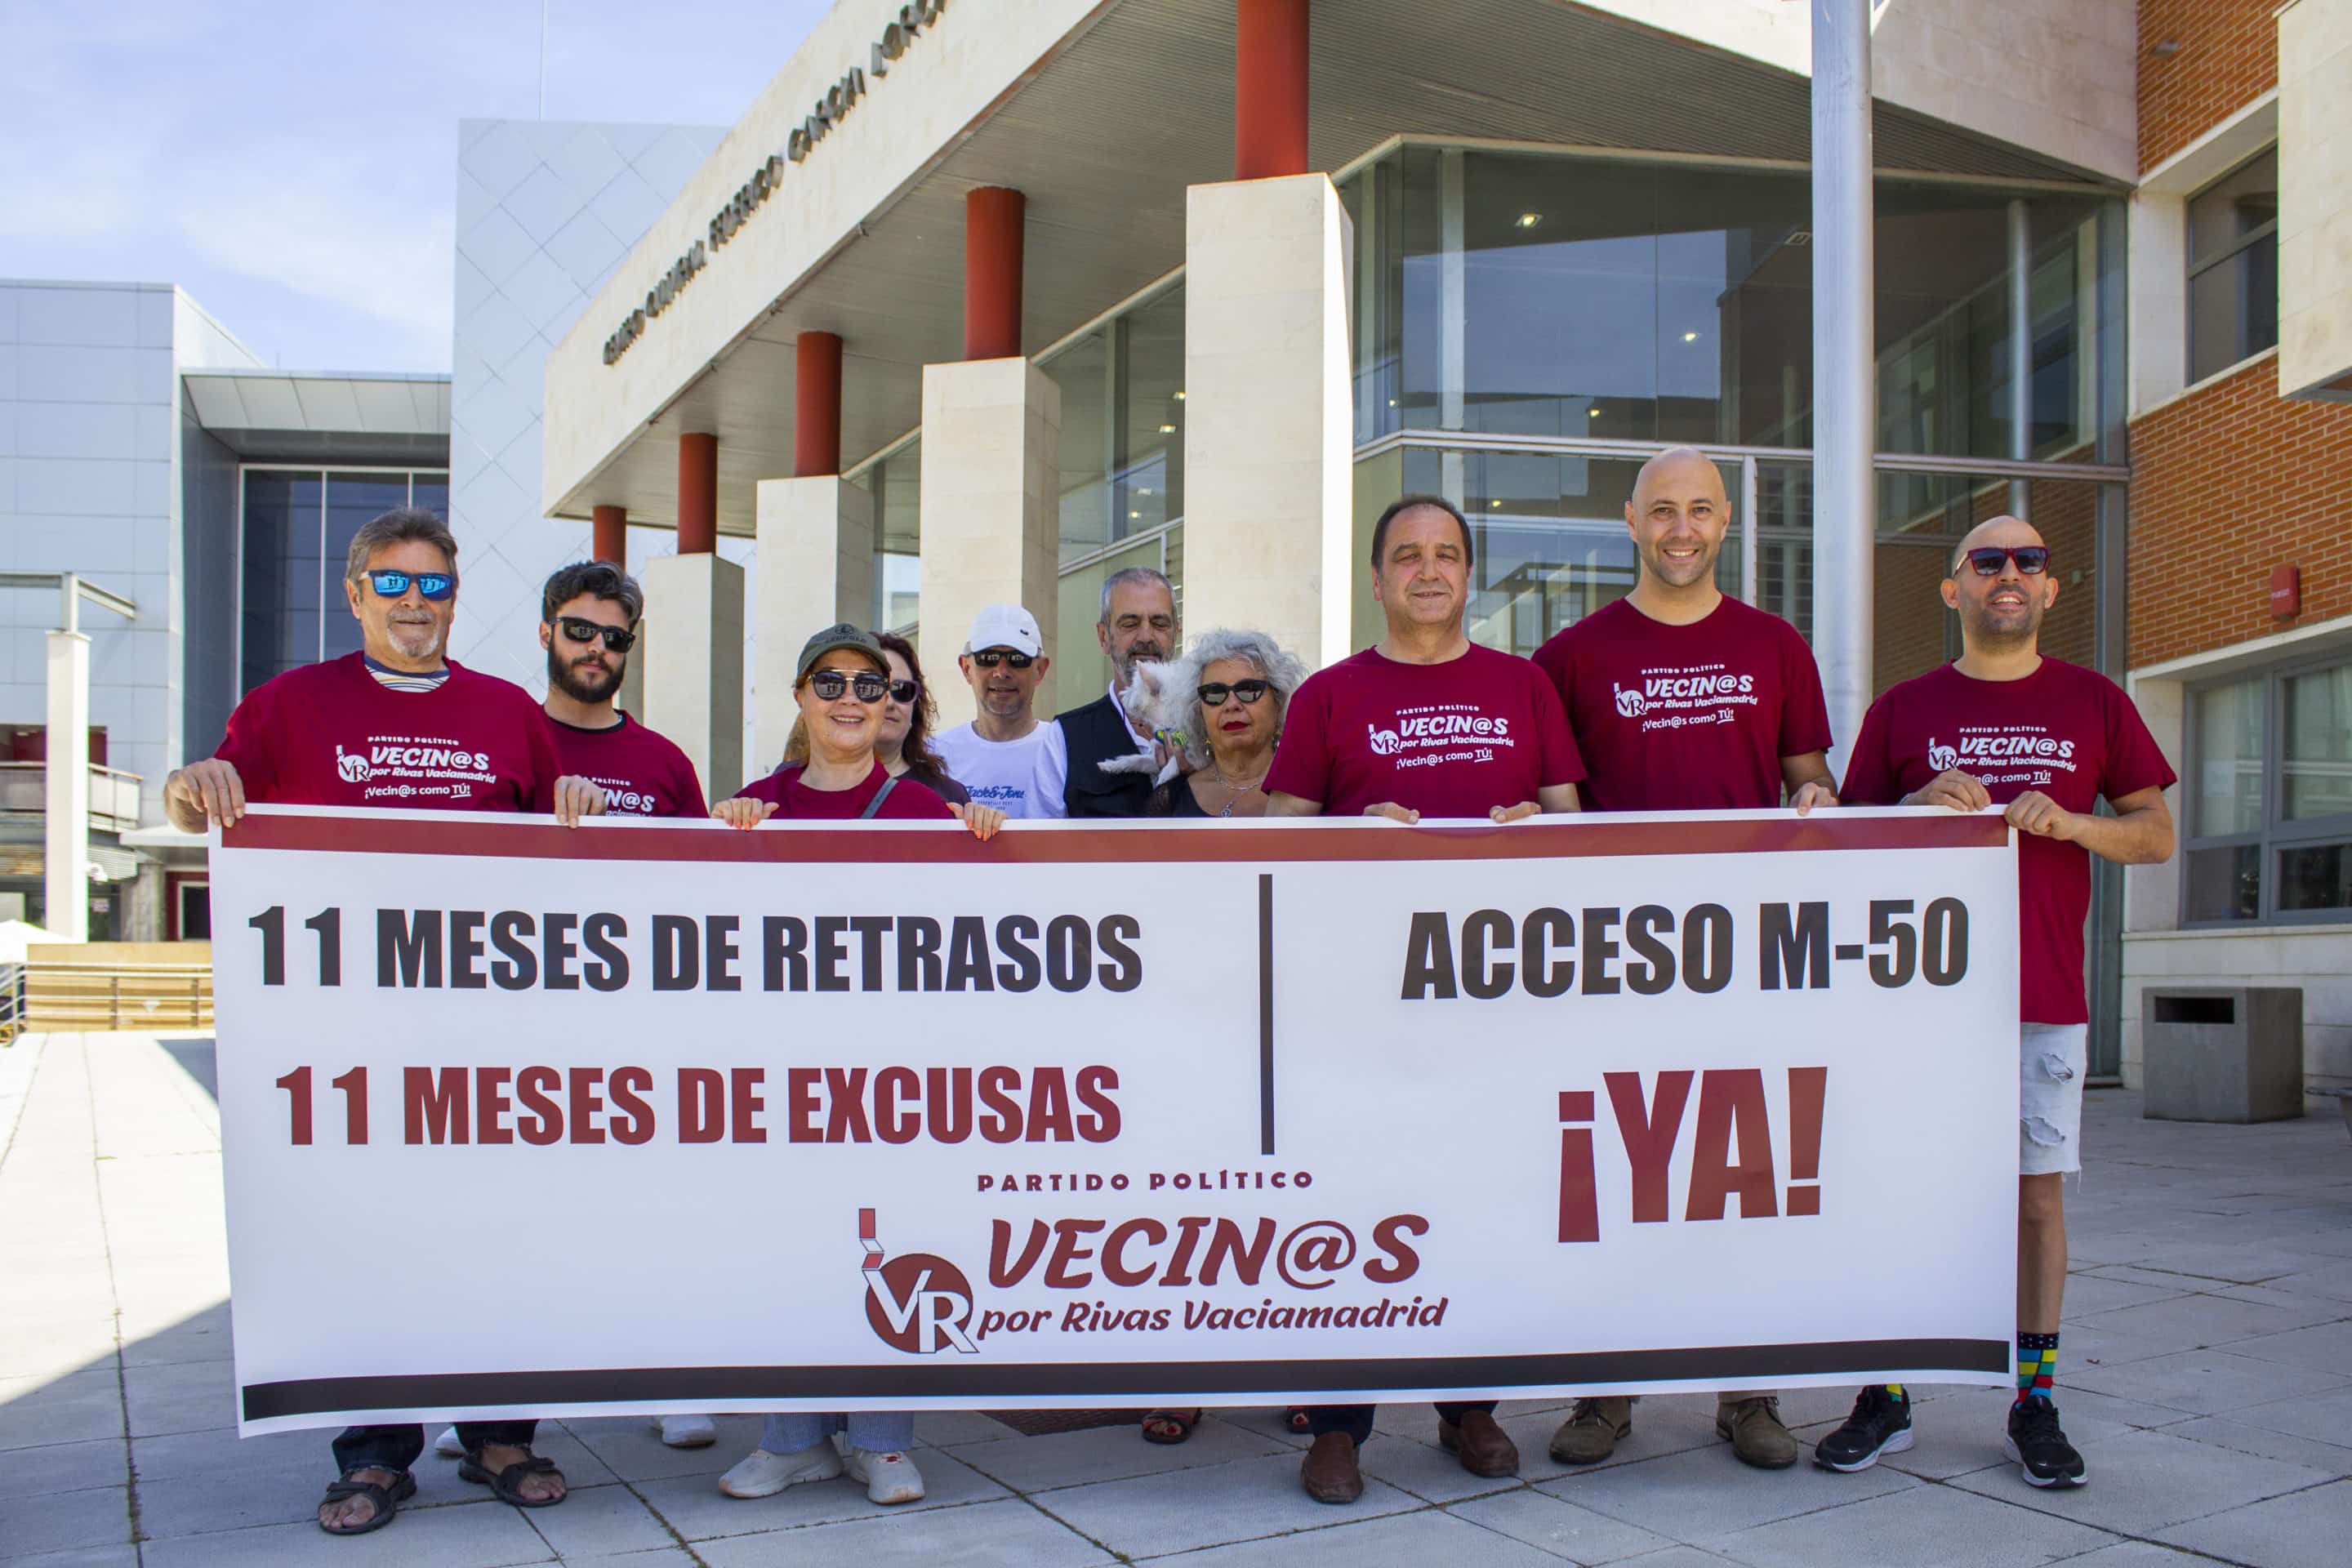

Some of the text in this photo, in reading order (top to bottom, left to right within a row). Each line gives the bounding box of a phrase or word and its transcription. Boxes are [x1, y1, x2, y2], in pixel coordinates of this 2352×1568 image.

[1642, 664, 1725, 675] PARTIDO POLÍTICO
[1645, 675, 1753, 697] VECIN@S
[1396, 704, 1480, 715] PARTIDO POLÍTICO
[1645, 694, 1757, 712] por Rivas Vaciamadrid
[1400, 715, 1508, 737] VECIN@S
[1642, 707, 1735, 732] ¡Vecin@s como TÚ!
[415, 737, 459, 746] POLÍTICO
[1399, 735, 1514, 750] por Rivas Vaciamadrid
[1960, 736, 2075, 759] VECIN@S
[371, 746, 489, 771] VECIN@S
[1396, 747, 1493, 770] ¡Vecin@s como TÚ!
[1957, 756, 2077, 773] por Rivas Vaciamadrid
[369, 767, 497, 784] por Rivas Vaciamadrid
[2001, 773, 2031, 783] como
[2031, 769, 2051, 784] TÚ!
[365, 783, 471, 800] ¡Vecin@s como TÚ!
[249, 906, 1142, 992] 11 MESES DE RETRASOS
[1401, 898, 1968, 1000] ACCESO M-50
[277, 1066, 1120, 1145] 11 MESES DE EXCUSAS
[1558, 1067, 1827, 1243] ¡YA!
[978, 1169, 1312, 1192] PARTIDO POLÍTICO
[989, 1214, 1429, 1290] VECIN@S
[862, 1268, 980, 1354] VR
[977, 1296, 1448, 1340] por Rivas Vaciamadrid
